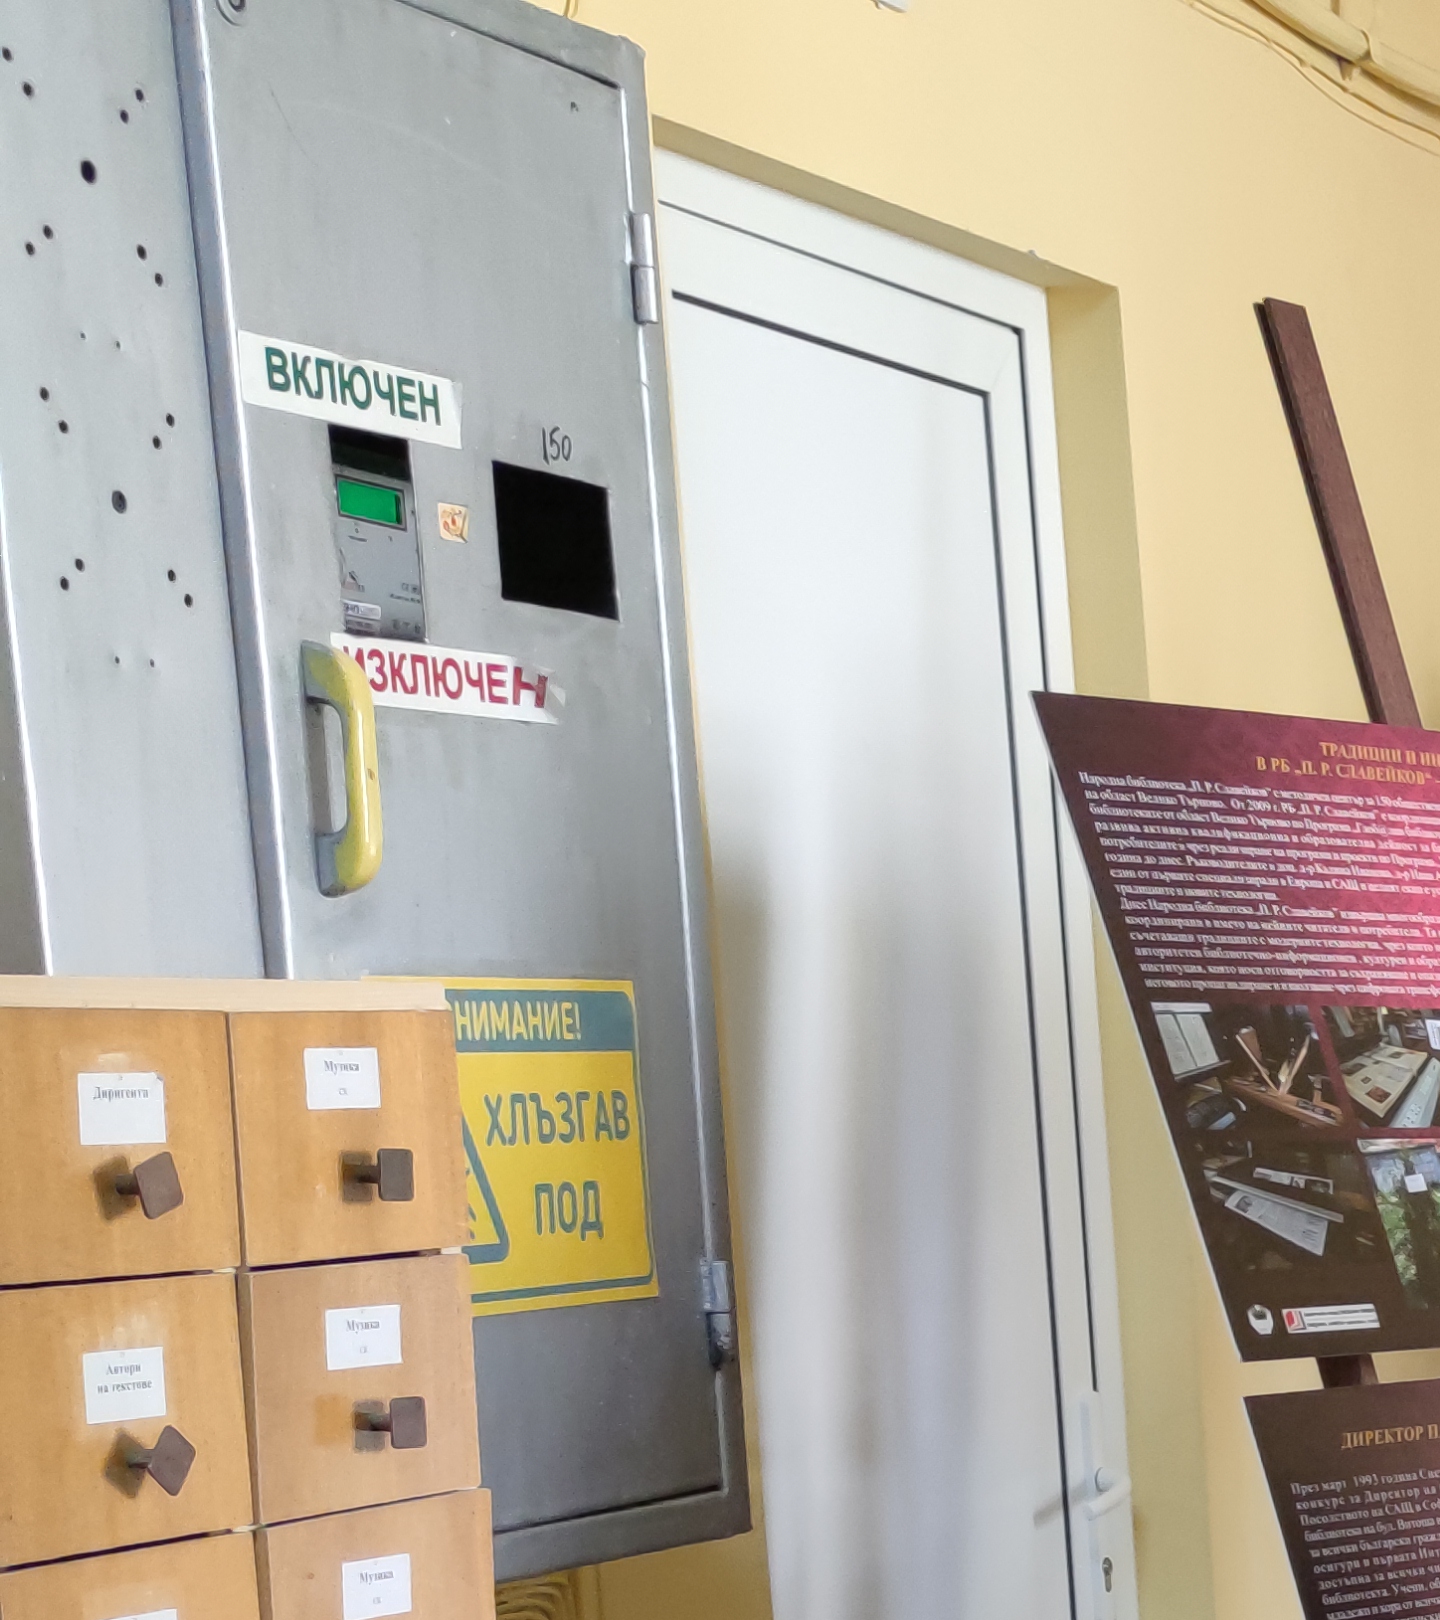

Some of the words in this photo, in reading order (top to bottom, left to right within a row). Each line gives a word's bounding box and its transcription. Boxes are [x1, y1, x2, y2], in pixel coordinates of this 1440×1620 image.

[264, 347, 441, 426] ВКЛЮЧЕН
[541, 427, 572, 463] 150
[1255, 755, 1267, 771] В
[1270, 757, 1290, 773] РБ
[1335, 763, 1432, 785] СЛАВЕЙКОВ“
[1319, 741, 1401, 763] ТРАДИЦИИ
[1405, 750, 1417, 765] И
[455, 1000, 582, 1041] НИМАНИЕ!
[483, 1090, 631, 1146] ХЛЪЗГАВ
[534, 1180, 604, 1241] ПОД
[1341, 1425, 1423, 1448] ДИРЕКТОР
